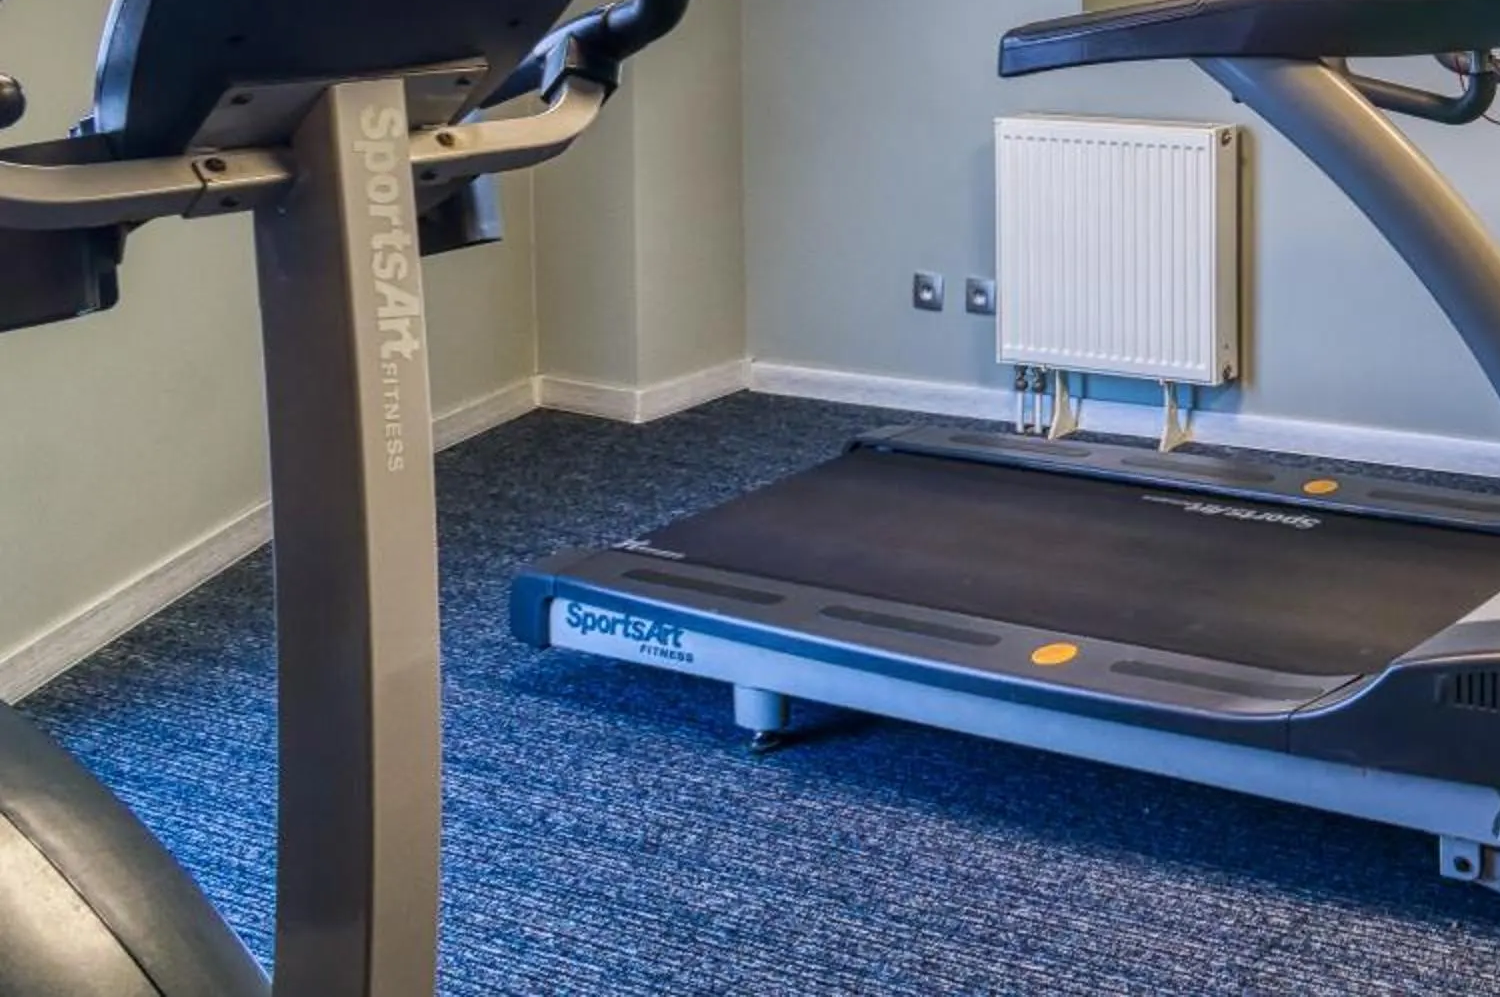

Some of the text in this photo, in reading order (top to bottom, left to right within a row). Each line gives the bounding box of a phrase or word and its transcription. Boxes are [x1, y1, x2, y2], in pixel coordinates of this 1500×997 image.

[354, 106, 422, 472] SportsArt FITNESS
[566, 601, 685, 649] SportsArt
[639, 643, 694, 664] FITNESS
